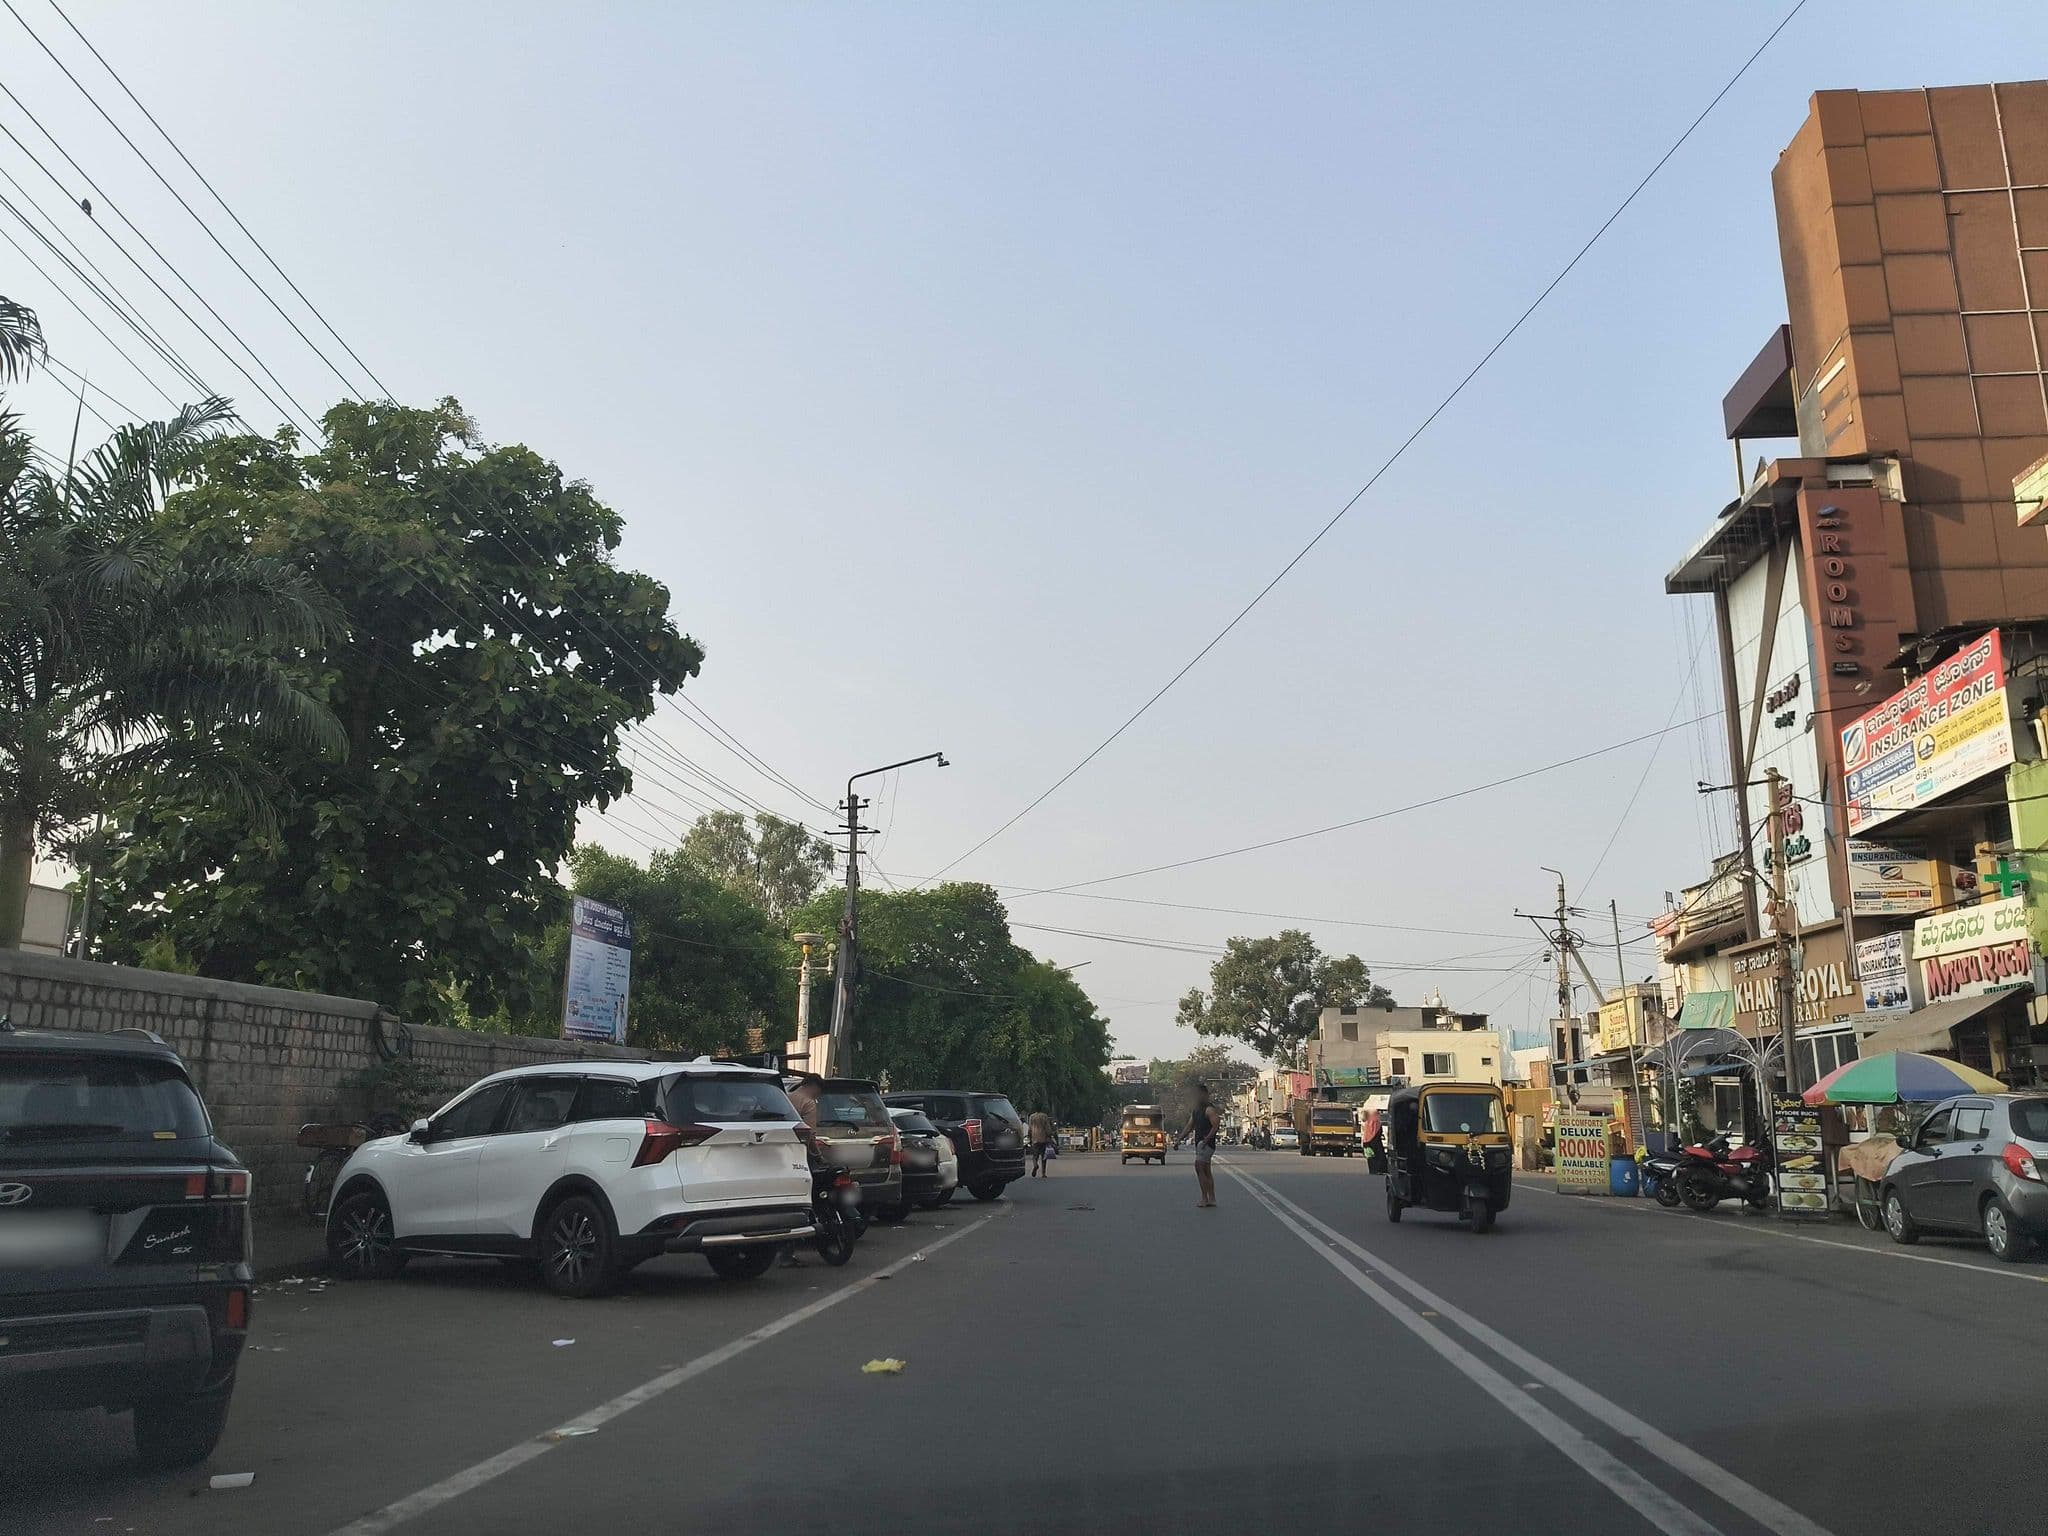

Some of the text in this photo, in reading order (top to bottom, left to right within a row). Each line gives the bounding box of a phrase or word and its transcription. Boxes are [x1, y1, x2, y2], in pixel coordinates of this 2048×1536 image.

[1820, 533, 1853, 652] ROOMS
[1870, 703, 1947, 758] INSURANCE
[1951, 674, 1995, 712] ZONE
[1920, 912, 1985, 953] ಮೈಸೂರು
[1861, 953, 1902, 973] INSURANCE ZONE
[1796, 961, 1853, 1002] ROYAL
[1560, 1127, 1602, 1137] DELUXE
[1571, 1119, 1603, 1127] COMFORTS
[1559, 1138, 1606, 1159] ROOMS
[1562, 1160, 1605, 1168] AVAILABLE
